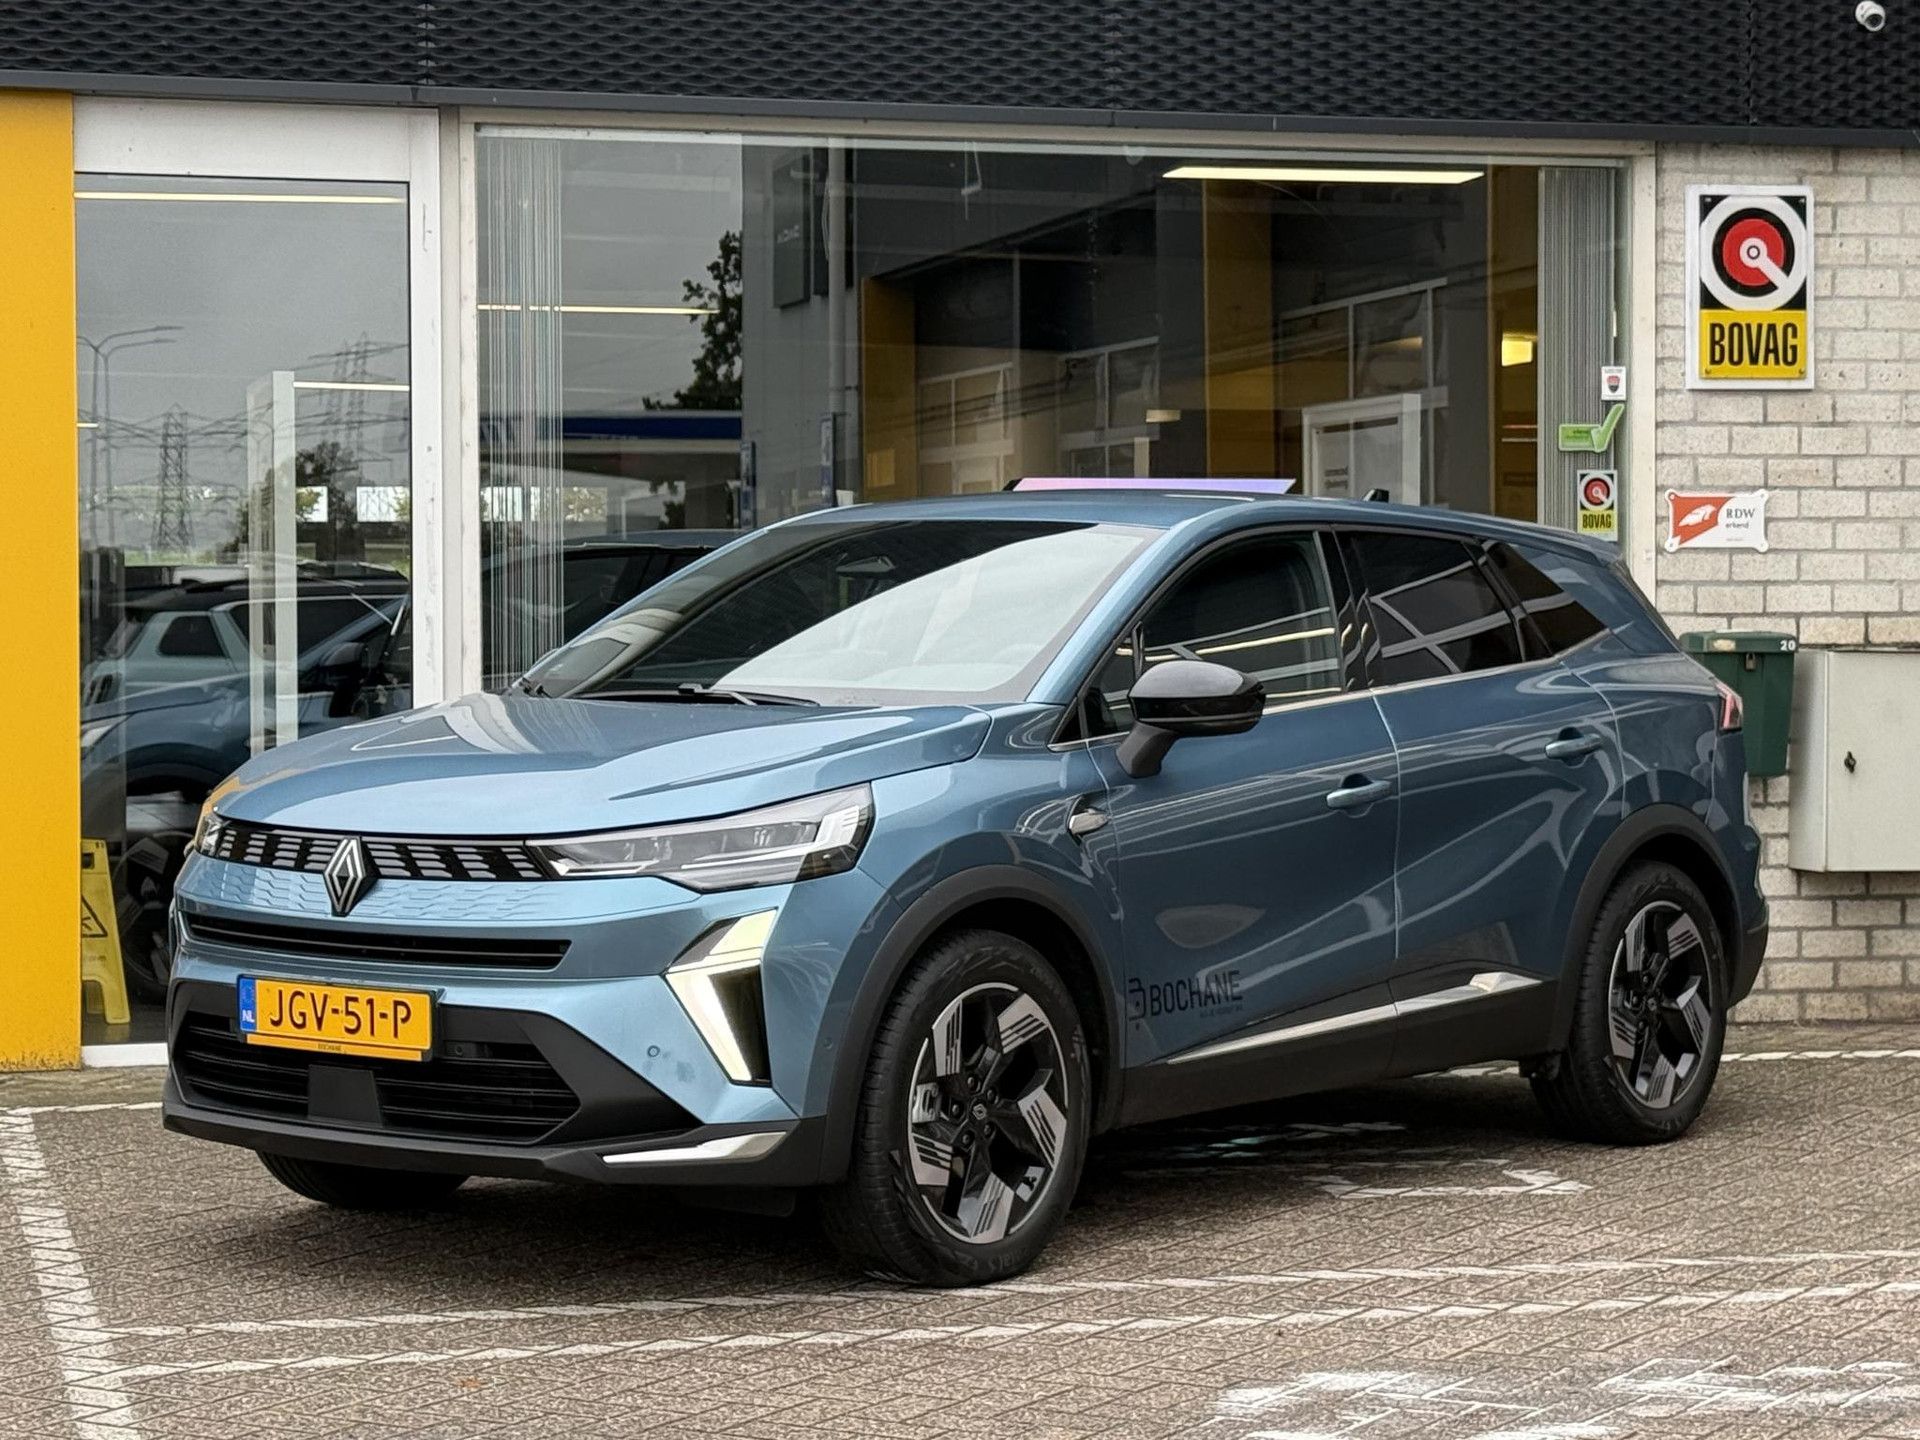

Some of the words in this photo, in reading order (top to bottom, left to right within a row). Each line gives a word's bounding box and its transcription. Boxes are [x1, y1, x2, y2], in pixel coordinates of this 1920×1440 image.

[1709, 322, 1798, 367] BOVAG
[1582, 513, 1612, 529] BOVAG
[1726, 508, 1755, 519] RDW
[1780, 640, 1796, 651] 20
[1150, 970, 1243, 1016] BOCHANE
[242, 1009, 255, 1022] NL
[269, 989, 412, 1039] JGV-51-P
